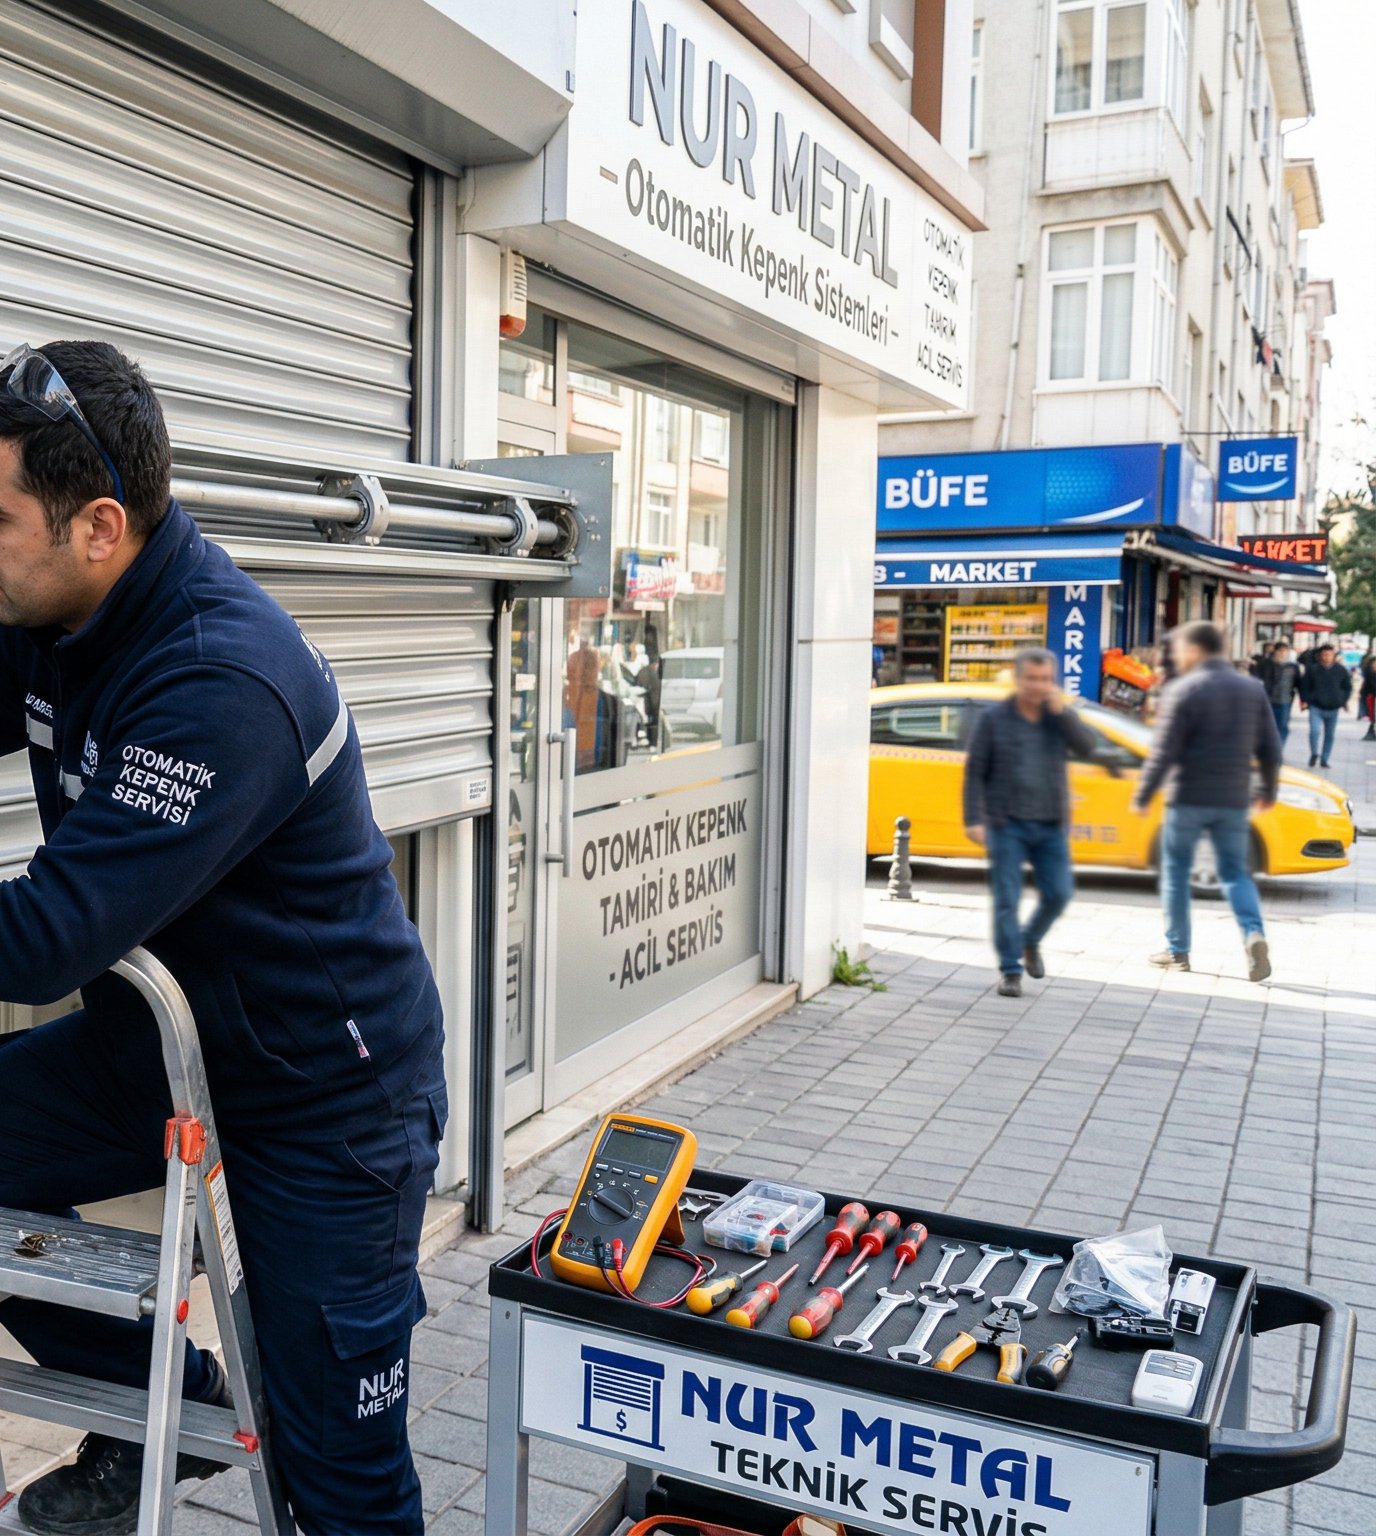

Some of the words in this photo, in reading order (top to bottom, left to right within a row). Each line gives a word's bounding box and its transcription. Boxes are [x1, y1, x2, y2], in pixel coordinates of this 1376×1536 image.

[629, 0, 758, 199] NUR
[772, 112, 898, 289] METAL
[626, 158, 734, 268] Otomatik
[741, 222, 808, 305] Kepenk
[814, 268, 888, 346] Sistemleri
[1228, 451, 1288, 474] BÜFE
[885, 469, 989, 509] BÜFE
[930, 561, 1037, 582] MARKET
[120, 763, 201, 806] KEPENK
[122, 745, 216, 789] OTOMATİK
[111, 784, 192, 826] SERVİSİ
[582, 809, 681, 881] OTOMATİK
[686, 798, 747, 849] KEPENK
[600, 867, 663, 937] TAMİRİ
[668, 872, 679, 910] &
[684, 852, 736, 904] BAKIM
[619, 928, 662, 990] ACİL
[666, 903, 723, 966] SERVİS
[357, 1381, 405, 1420] METAL
[359, 1357, 404, 1402] NUR
[681, 1369, 818, 1453] NUR
[841, 1407, 1072, 1513] METAL
[710, 1440, 870, 1512] TEKNİK
